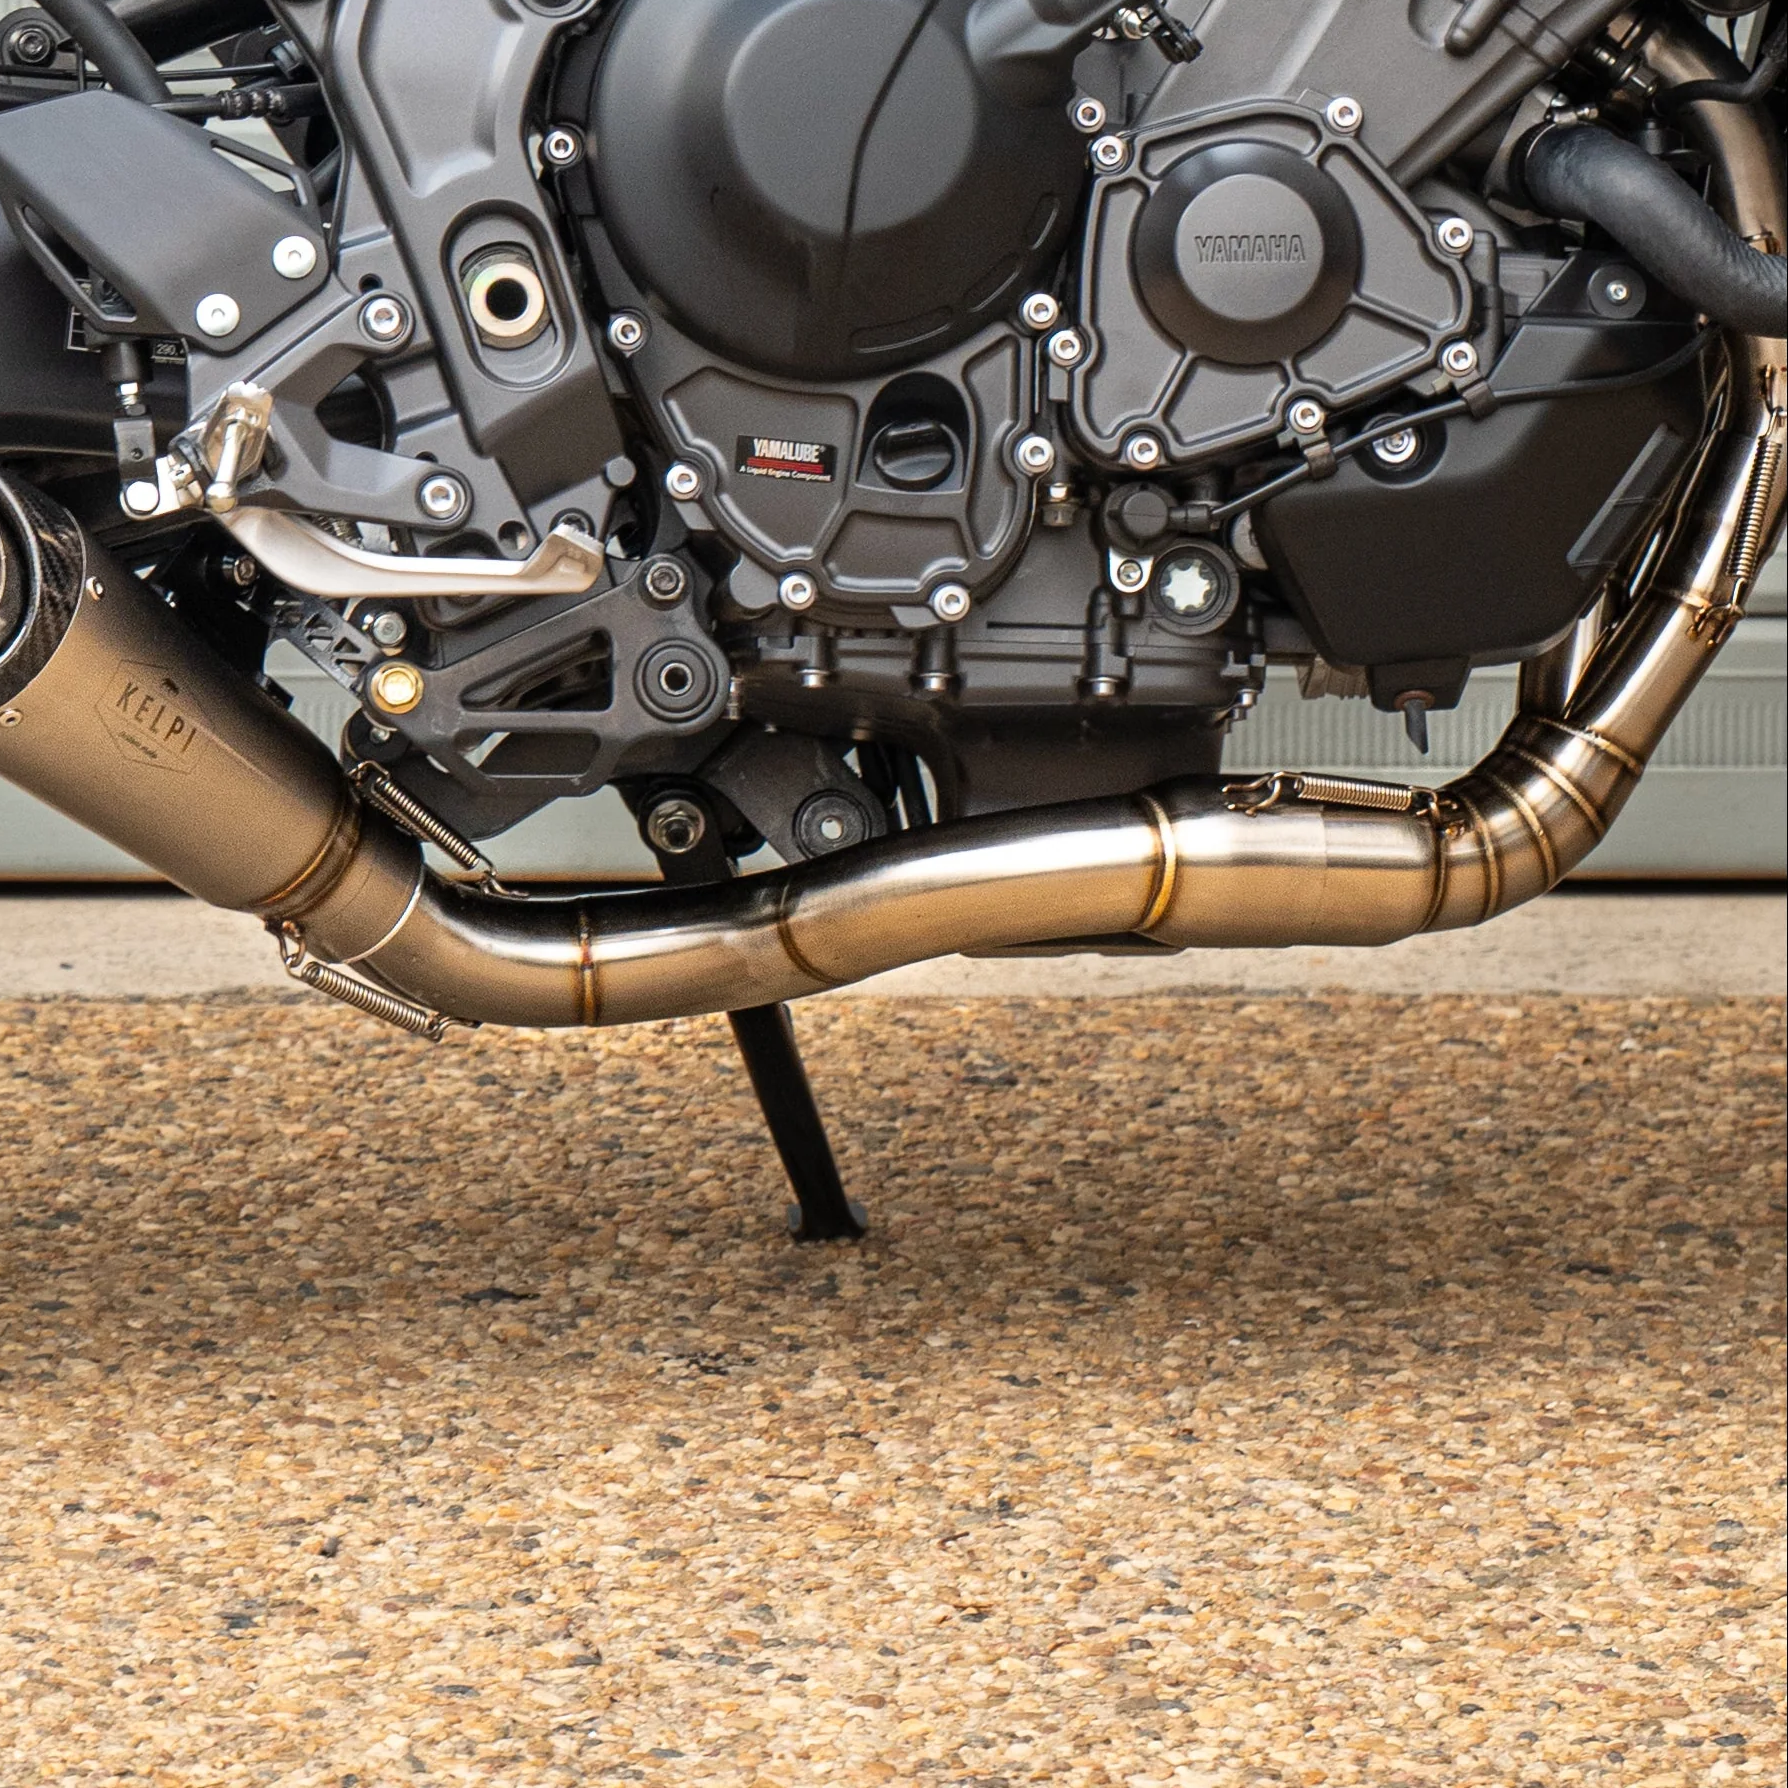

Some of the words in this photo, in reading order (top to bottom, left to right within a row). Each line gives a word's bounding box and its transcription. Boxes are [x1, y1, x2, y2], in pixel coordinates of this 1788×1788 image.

[1194, 234, 1306, 262] YAMAHA
[739, 465, 746, 473] A
[116, 682, 197, 754] KELPI
